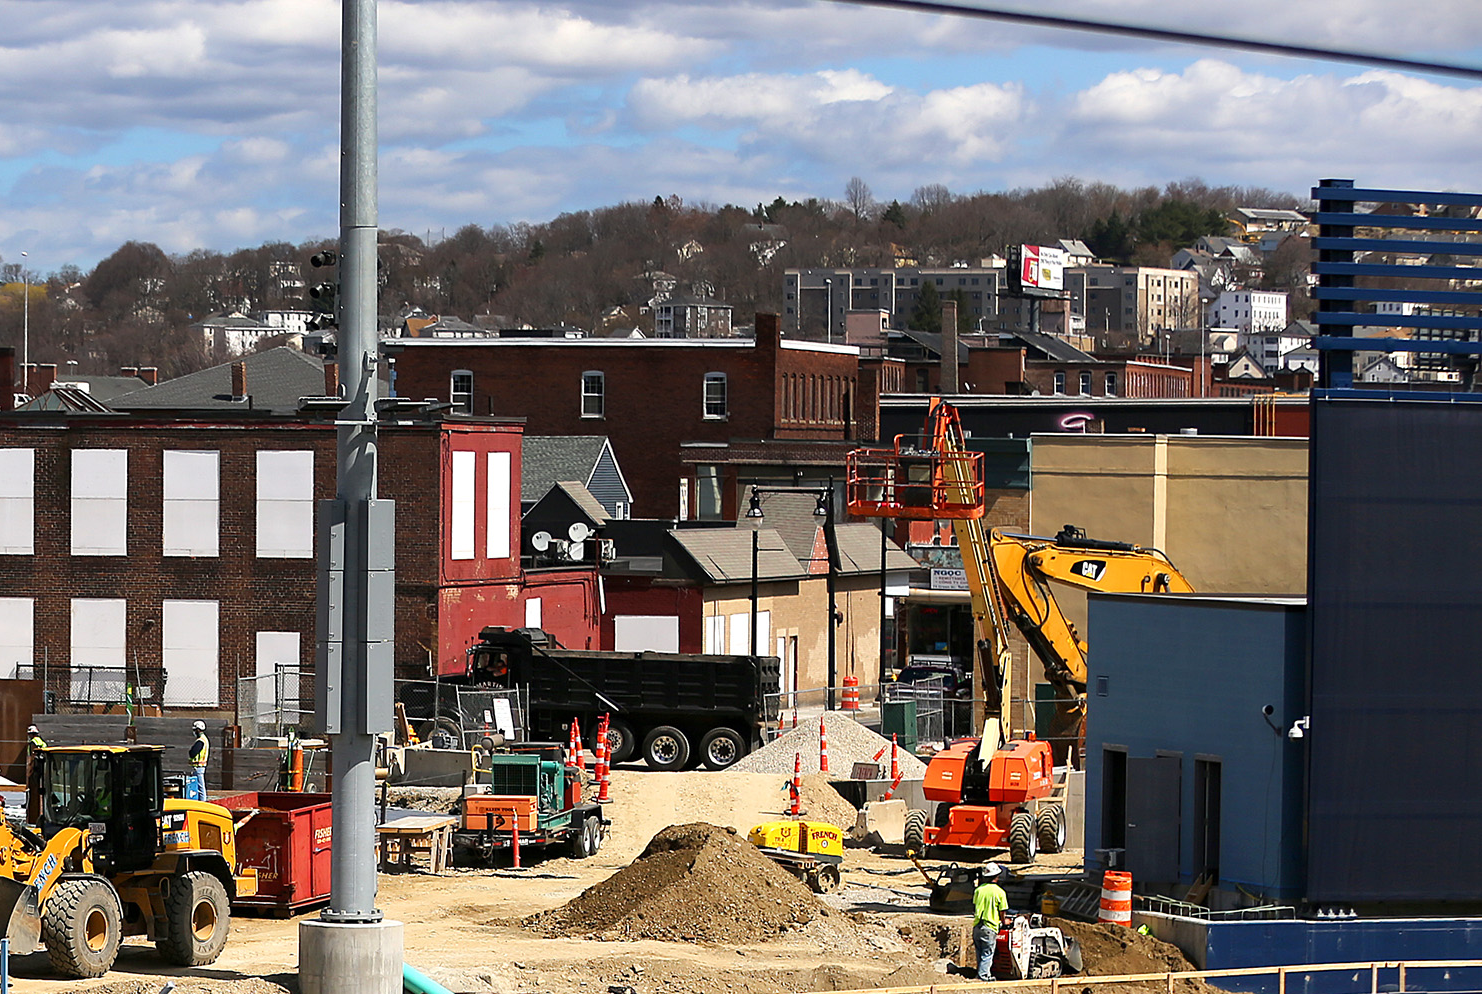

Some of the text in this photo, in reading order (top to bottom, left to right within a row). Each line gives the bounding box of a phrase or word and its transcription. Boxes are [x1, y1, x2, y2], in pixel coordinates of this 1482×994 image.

[1081, 561, 1098, 579] CAT
[161, 814, 172, 829] AT
[162, 831, 190, 845] FRENCH
[811, 830, 838, 841] FRENCH
[33, 852, 57, 892] ENCH
